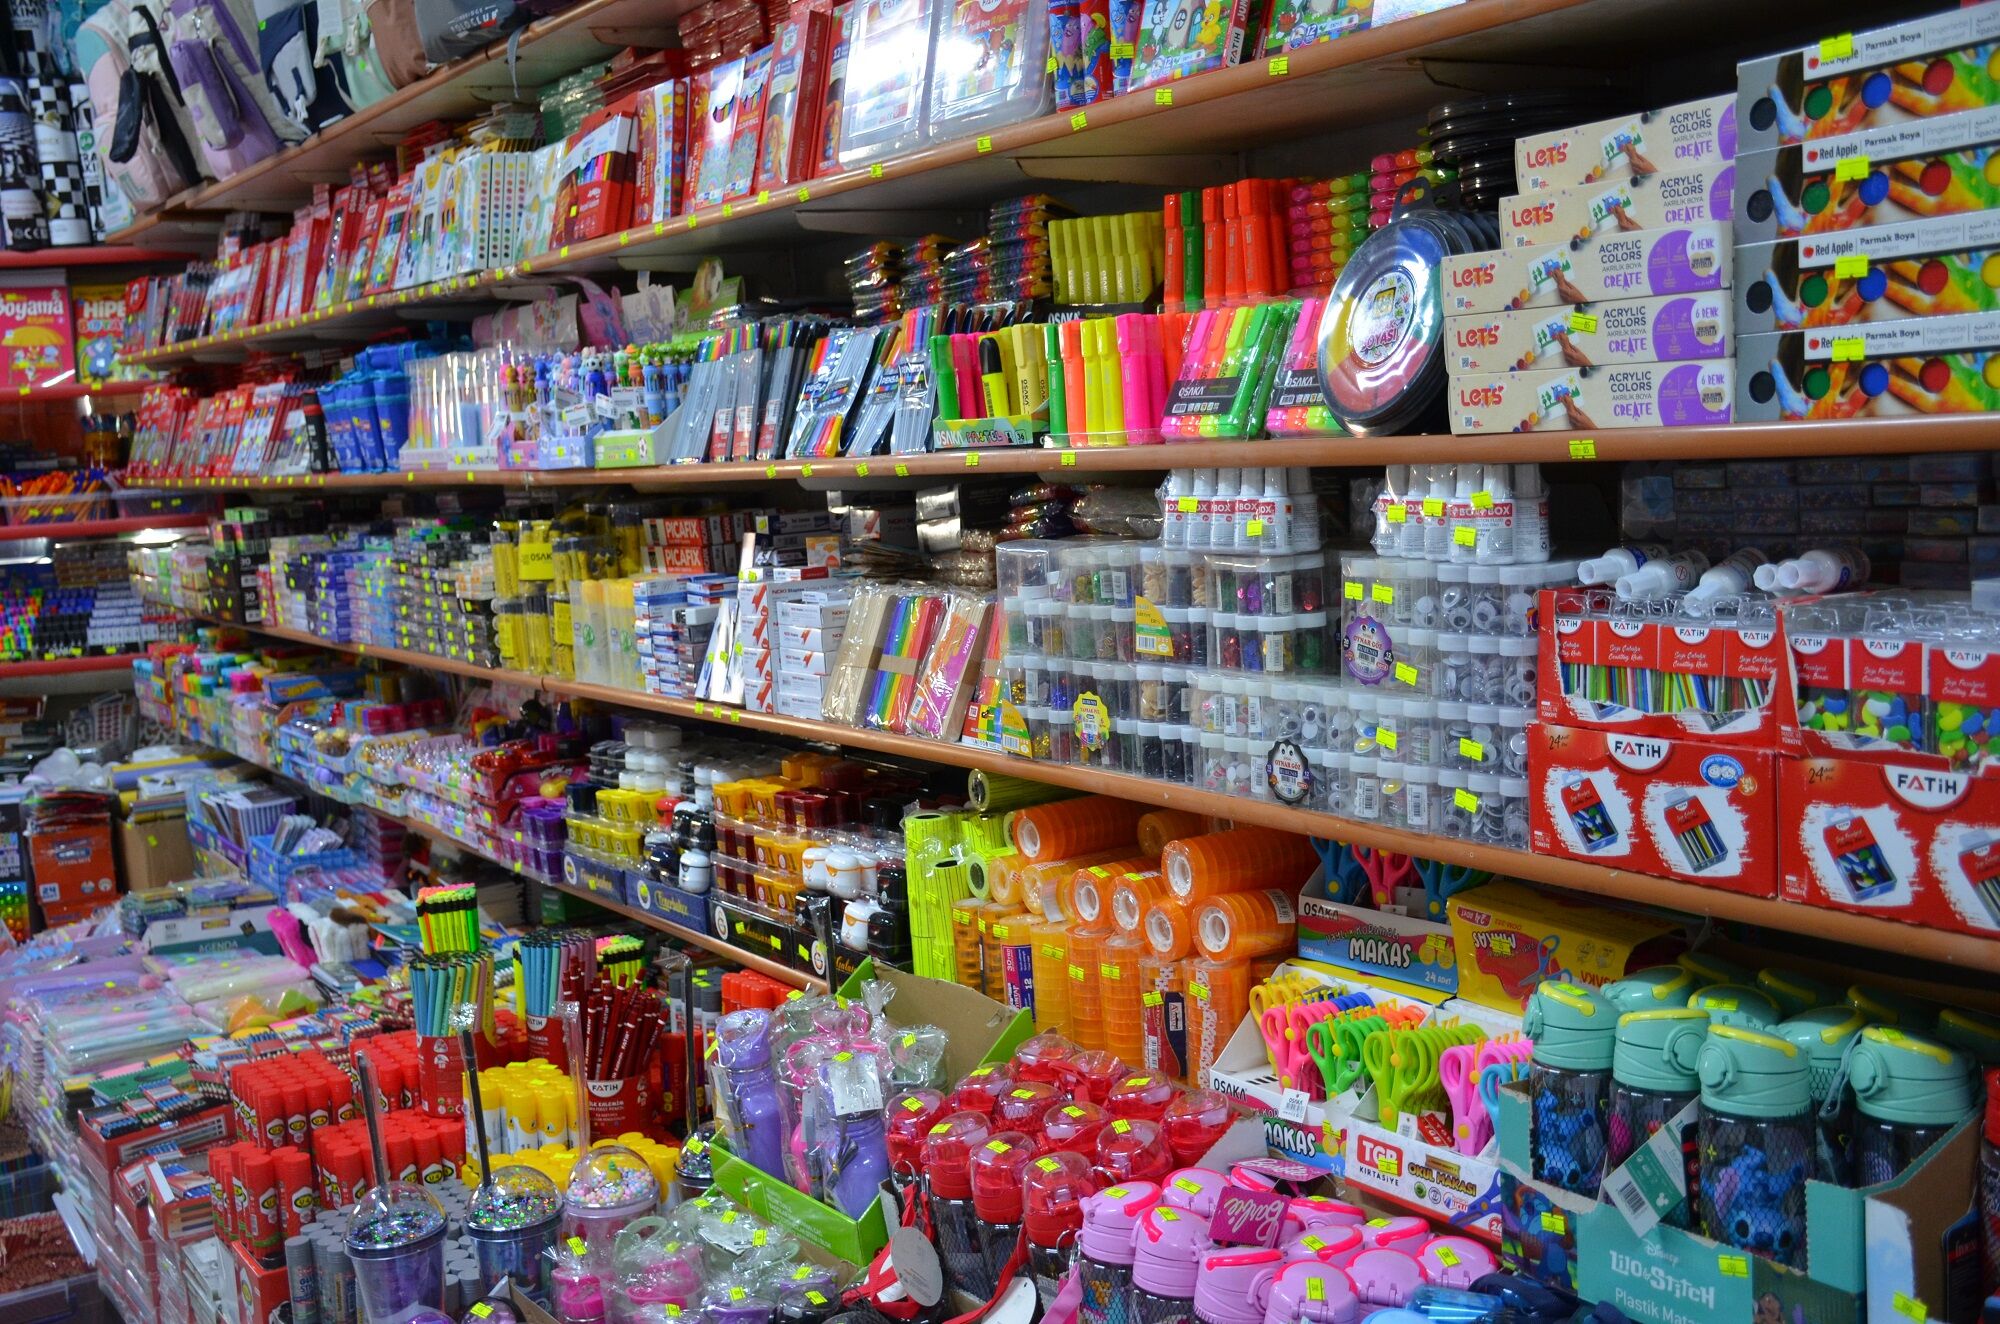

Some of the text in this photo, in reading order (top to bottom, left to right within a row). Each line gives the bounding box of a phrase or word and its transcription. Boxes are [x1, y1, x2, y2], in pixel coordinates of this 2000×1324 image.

[1865, 31, 1922, 51] Parmak Boya
[1669, 108, 1712, 125] ACRYLIC
[1671, 120, 1712, 135] COLORS
[1864, 131, 1921, 148] Parmak Boya
[1674, 140, 1713, 160] CREATE
[1819, 143, 1858, 160] Red Apple
[1659, 174, 1703, 190] ACRYLIC
[1661, 185, 1704, 199] COLORS
[1665, 205, 1704, 224] CREATE
[1860, 230, 1916, 246] Parmak Boya
[1599, 240, 1642, 254] ACRYLIC
[1815, 241, 1854, 256] Red Apple
[1601, 251, 1642, 264] COLORS
[1604, 271, 1643, 291] CREATE
[1603, 306, 1646, 319] ACRYLIC
[1605, 317, 1647, 329] COLORS
[1865, 331, 1898, 340] Parmak
[1899, 329, 1921, 338] Boya
[1608, 338, 1648, 355] CREATE
[1608, 371, 1652, 384] ACRYLIC
[1178, 386, 1206, 397] OSAKA
[1610, 382, 1652, 393] COLORS
[1613, 402, 1653, 420] CREATE
[665, 518, 700, 538] PICAFIX
[665, 548, 701, 566] PICAFIX
[963, 628, 976, 654] OSAKA
[1808, 766, 1824, 784] 24
[1304, 902, 1340, 920] OSAKA
[1349, 936, 1412, 969] MAKAS
[1213, 1077, 1248, 1102] OSAKA
[1407, 1162, 1477, 1197] OKUL MAKASI
[1223, 1197, 1285, 1249] Barbie
[1641, 1238, 1680, 1268] Disney
[1615, 1287, 1660, 1320] Plastik
